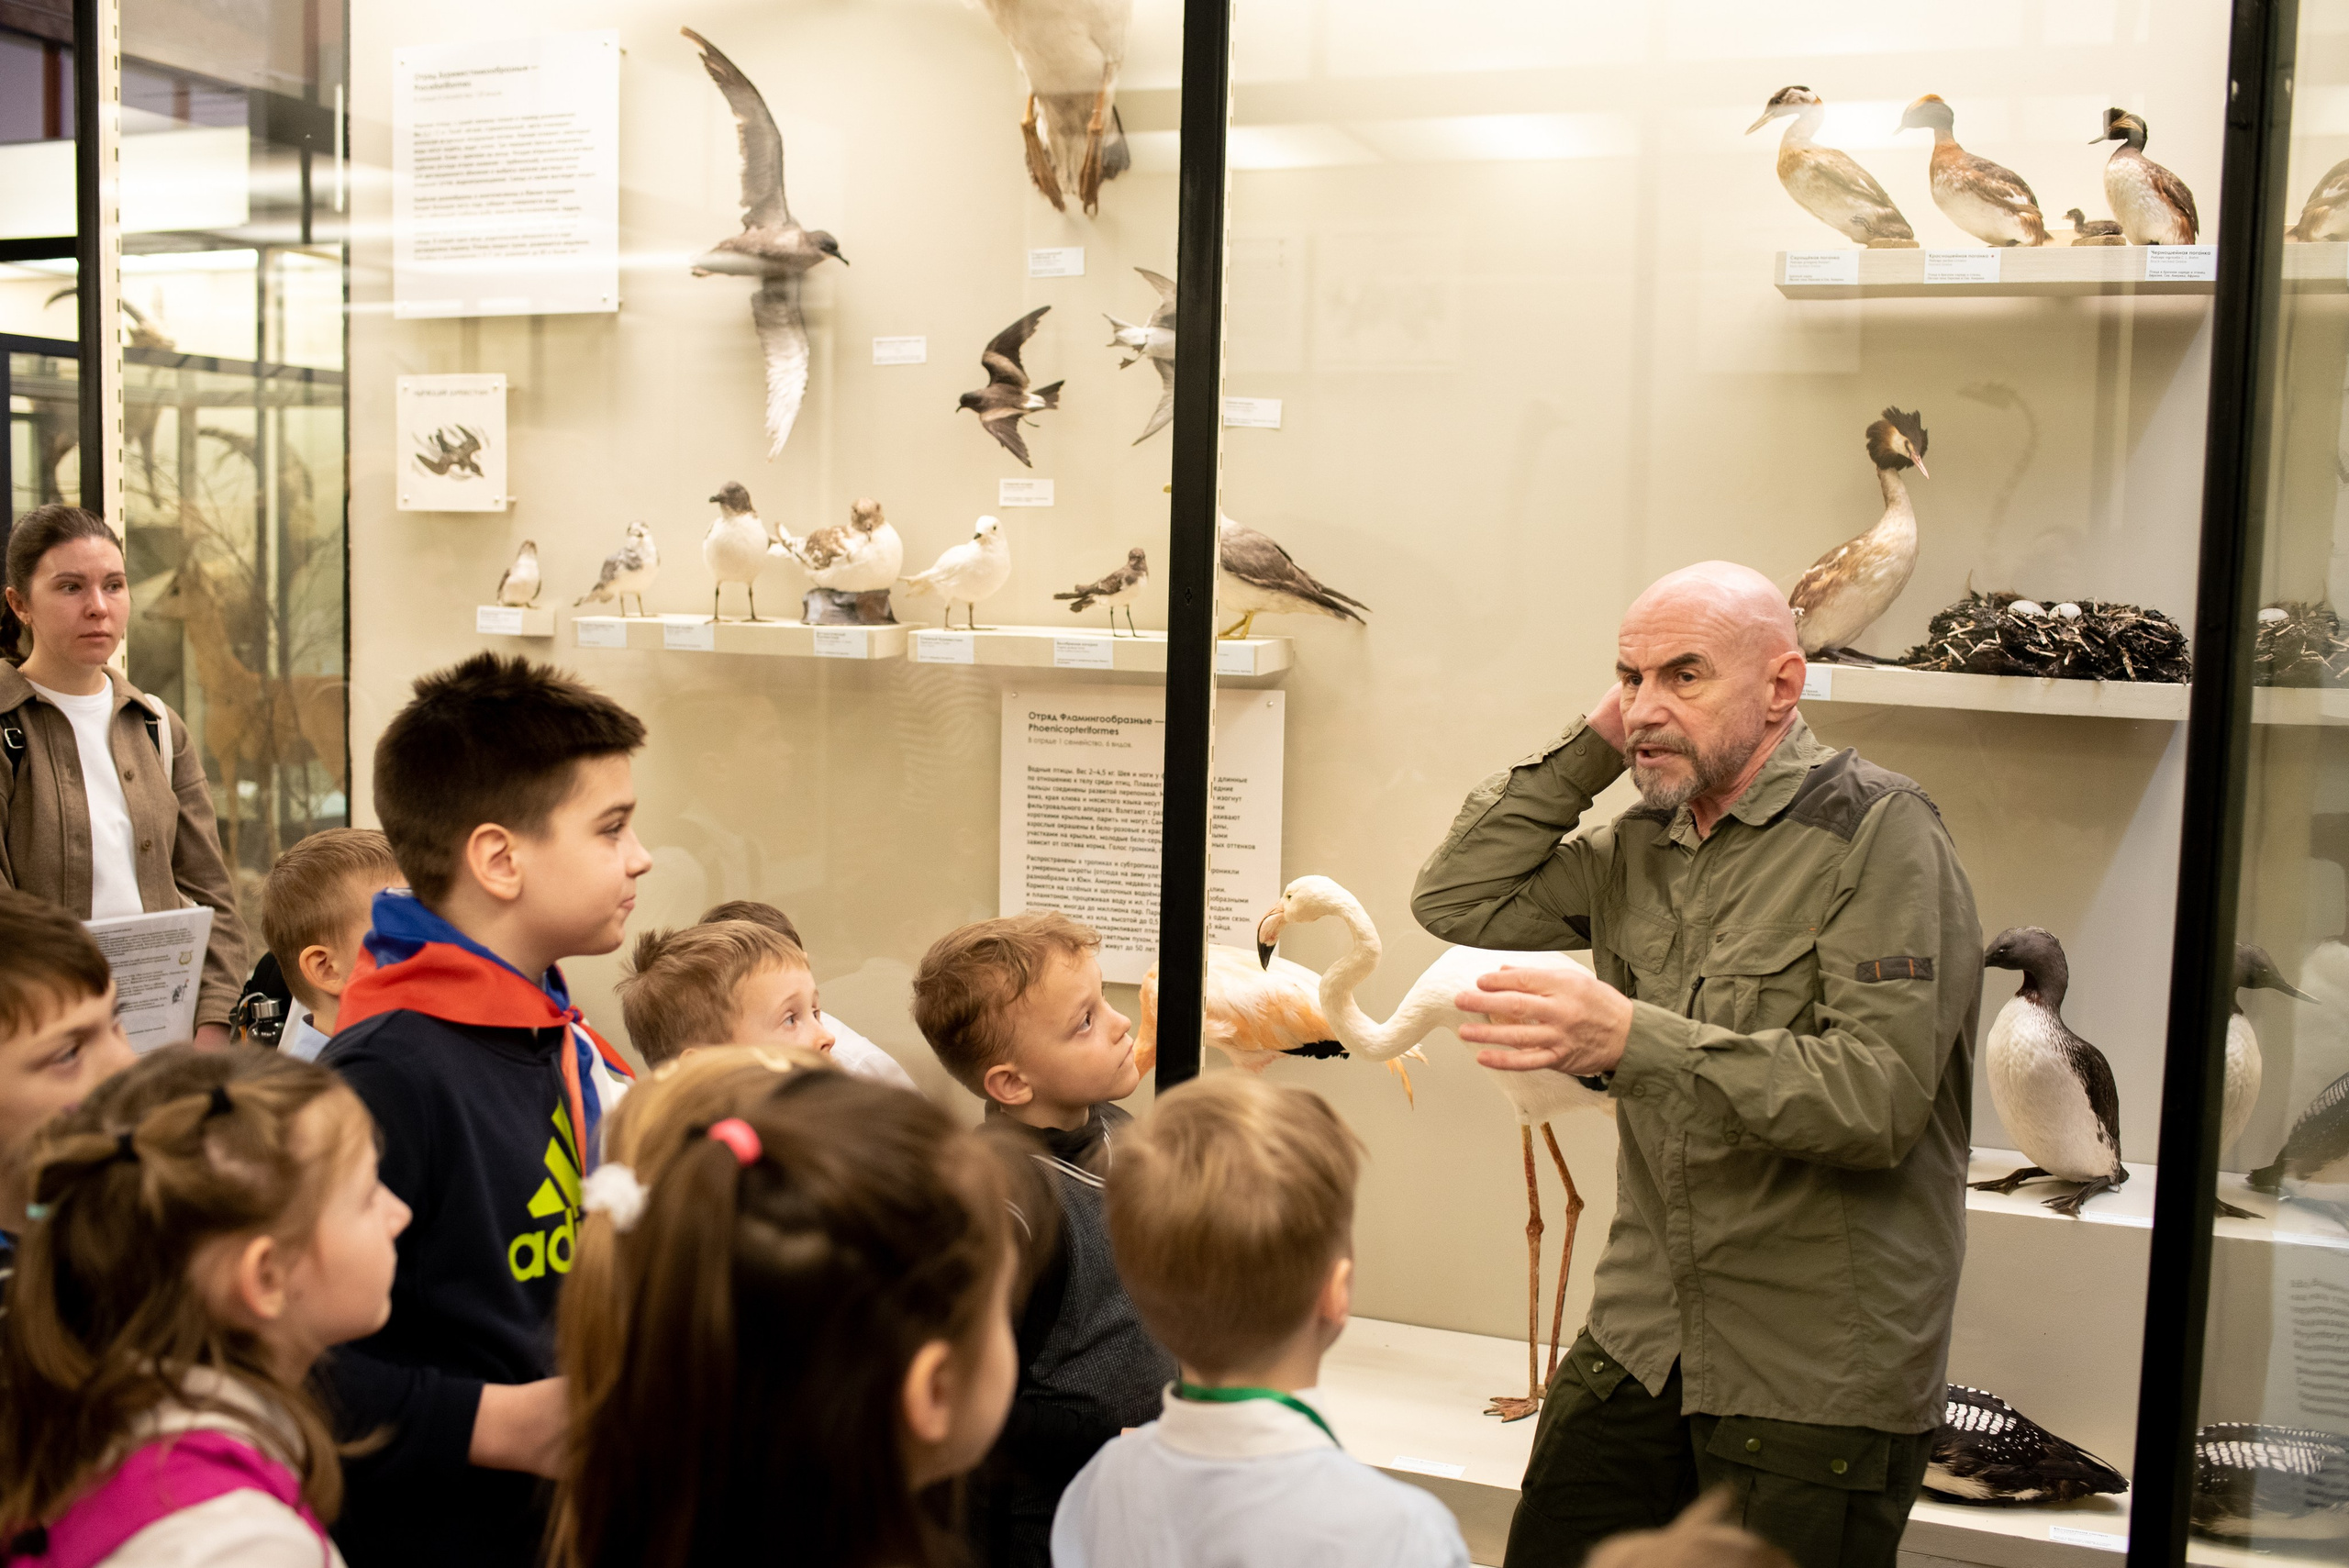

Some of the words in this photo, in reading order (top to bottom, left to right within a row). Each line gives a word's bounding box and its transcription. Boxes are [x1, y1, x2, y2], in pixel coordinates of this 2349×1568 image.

[1028, 712, 1057, 721] Отряд
[1060, 713, 1151, 725] Фламингообразные
[1028, 723, 1118, 736] Phoenicopteriformes
